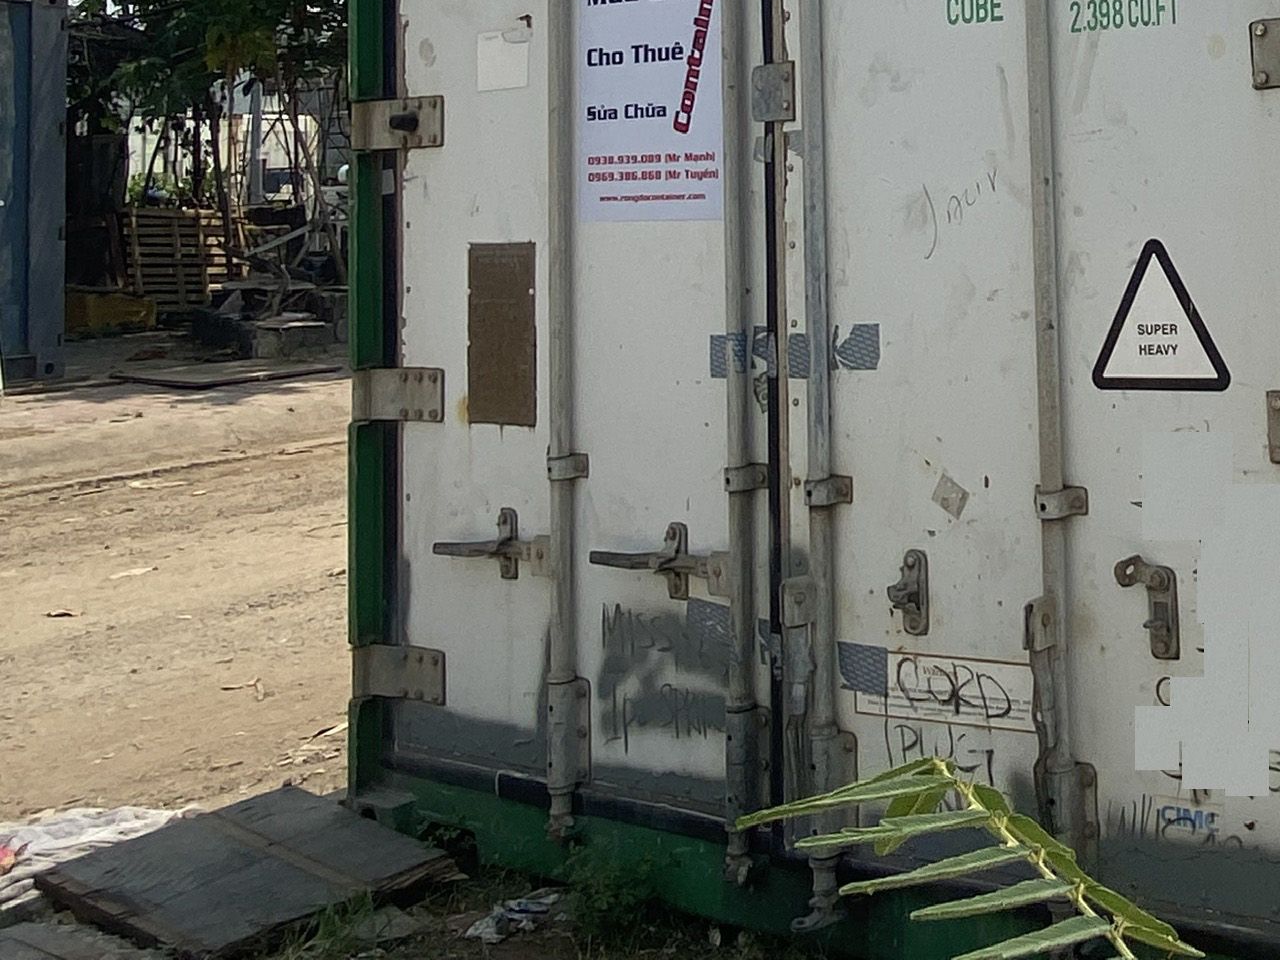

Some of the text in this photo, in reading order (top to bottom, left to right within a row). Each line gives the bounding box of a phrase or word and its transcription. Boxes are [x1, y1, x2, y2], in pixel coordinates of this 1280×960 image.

[586, 42, 684, 67] Cho Thuê
[1137, 323, 1178, 336] SUPER
[1138, 344, 1179, 356] HEAVY
